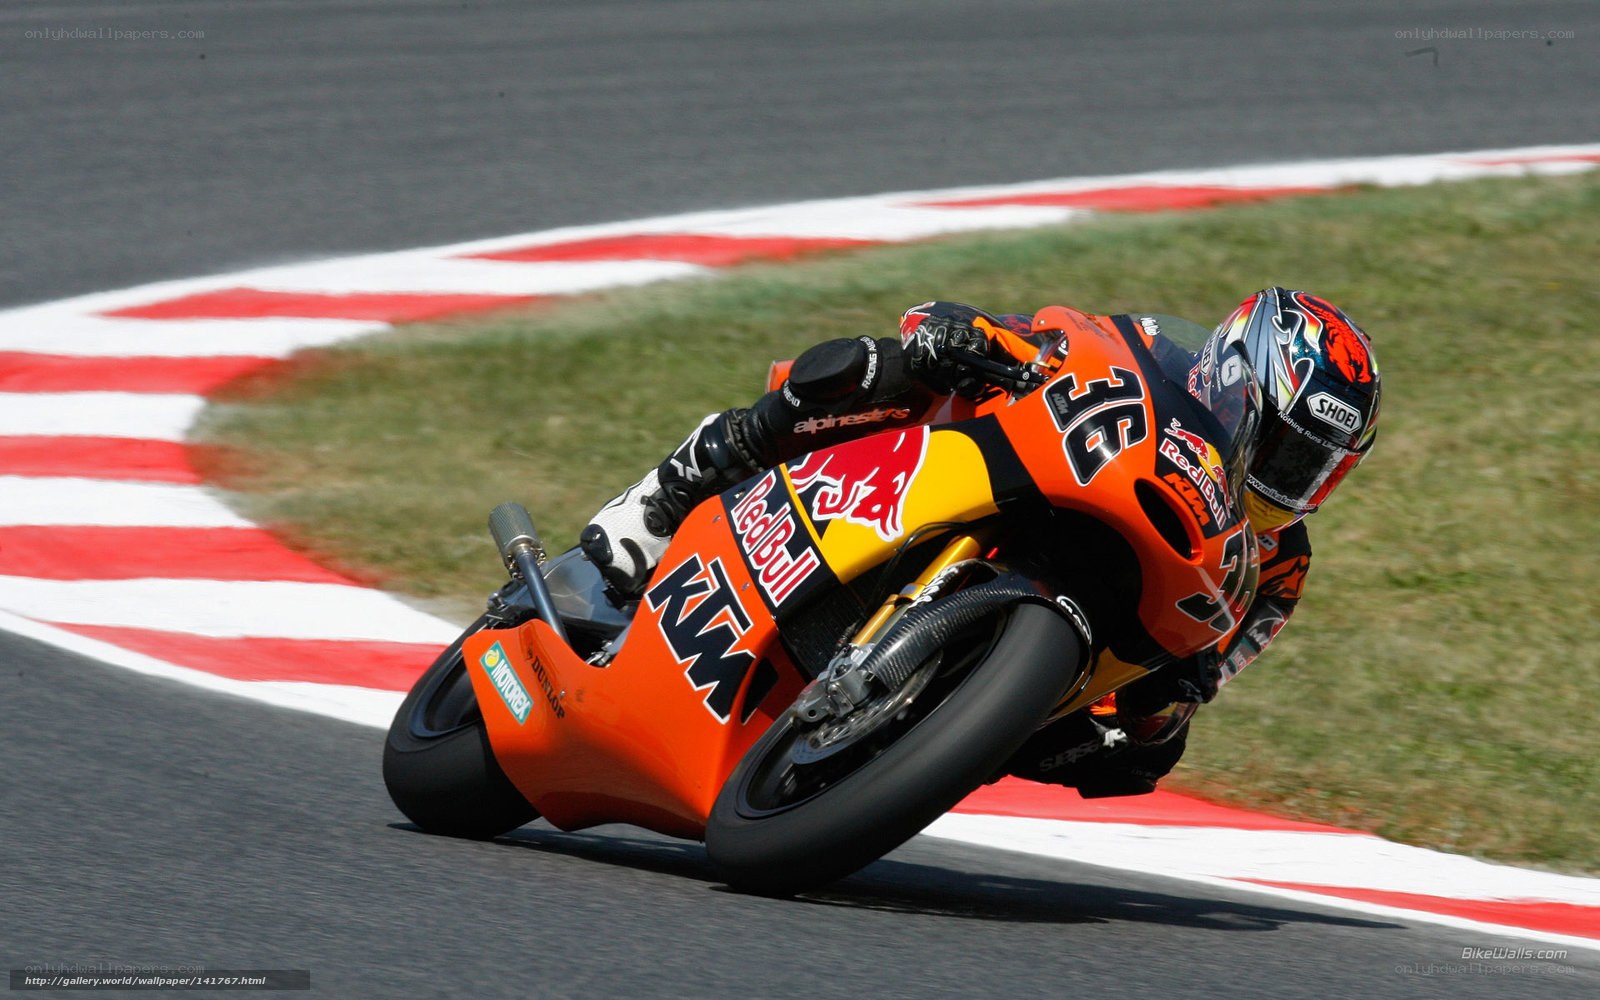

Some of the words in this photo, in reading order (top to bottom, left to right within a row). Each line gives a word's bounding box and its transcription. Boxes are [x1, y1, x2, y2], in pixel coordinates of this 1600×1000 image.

[861, 352, 878, 389] RACING
[1043, 365, 1148, 487] 36
[1277, 410, 1305, 434] Nothing
[1304, 430, 1322, 444] Runs
[1315, 399, 1358, 429] SHOEI
[1163, 471, 1211, 527] KTM
[643, 552, 760, 725] KTM
[490, 658, 533, 721] MOTOREX
[532, 655, 565, 719] DUNLOP
